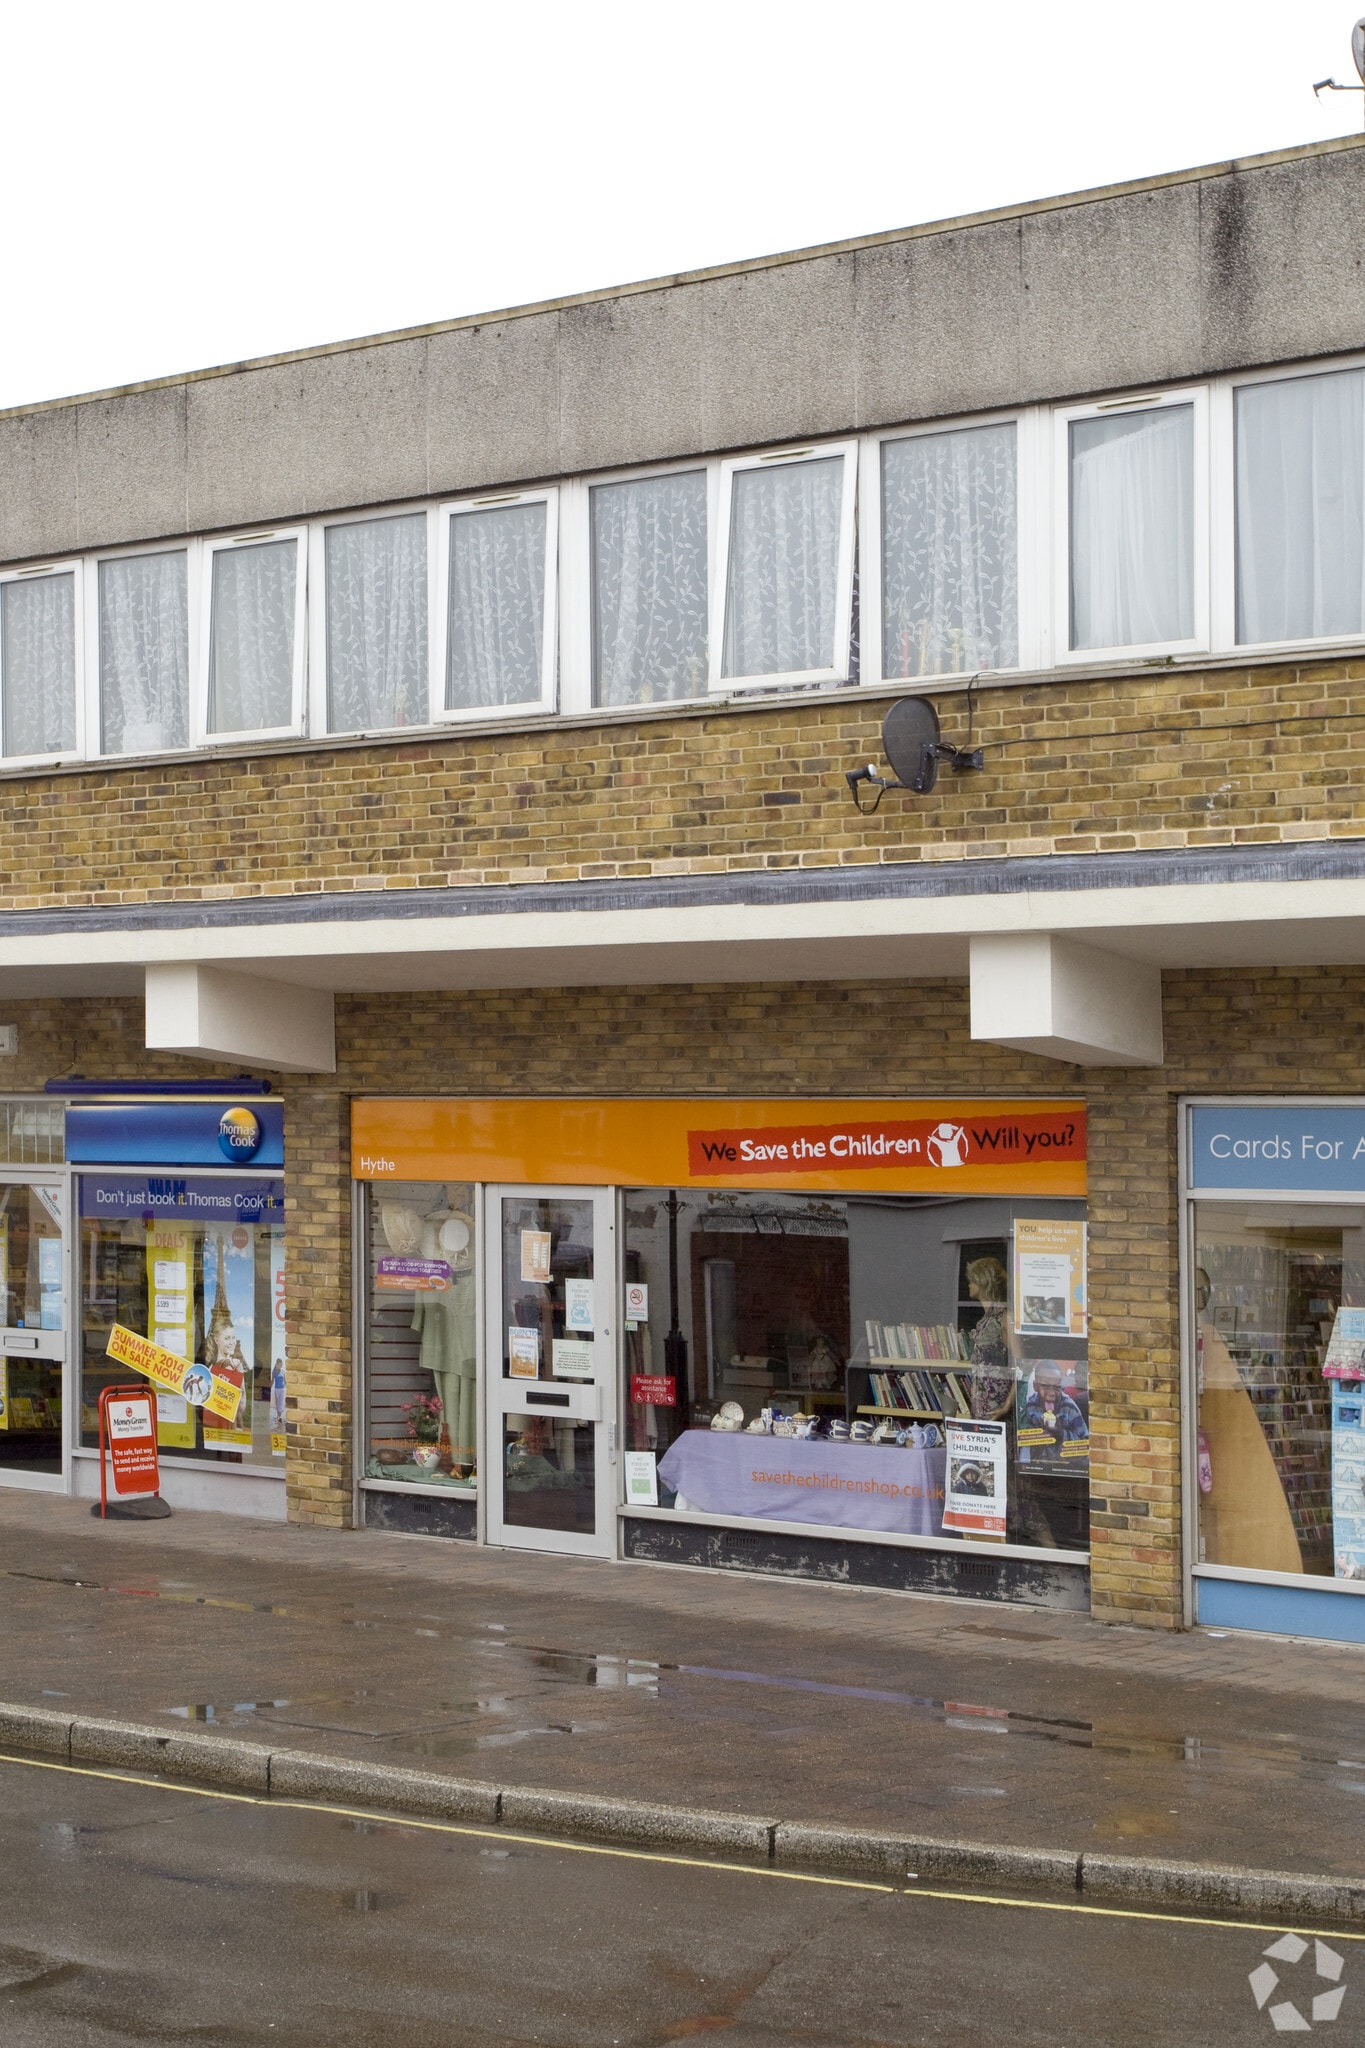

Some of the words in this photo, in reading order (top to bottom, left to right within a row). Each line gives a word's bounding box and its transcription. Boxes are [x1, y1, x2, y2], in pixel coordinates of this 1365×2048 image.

[219, 1122, 256, 1136] Thomas
[229, 1135, 256, 1147] Cook
[701, 1142, 737, 1163] We
[740, 1139, 788, 1162] Save
[791, 1137, 826, 1158] the
[829, 1134, 921, 1157] Children
[971, 1126, 1019, 1151] Will
[1023, 1124, 1075, 1155] you?
[1210, 1134, 1291, 1159] Cards
[1302, 1135, 1344, 1160] For
[361, 1157, 396, 1174] Hythe
[96, 1189, 125, 1204] Don't
[126, 1190, 146, 1206] just
[148, 1192, 176, 1206] book
[188, 1194, 232, 1208] Thomas
[234, 1193, 264, 1208] Cook
[266, 1195, 277, 1209] it.
[1019, 1225, 1037, 1233] YOU
[1038, 1226, 1053, 1235] help
[154, 1233, 185, 1249] DEALS
[114, 1329, 157, 1360] SUMMER
[160, 1353, 185, 1374] 2014
[111, 1342, 127, 1357] ON
[128, 1351, 152, 1370] SALE
[152, 1364, 182, 1384] NOW
[636, 1377, 652, 1385] Please
[662, 1378, 672, 1386] for
[641, 1385, 667, 1393] assistance
[113, 1417, 148, 1427] MoneyGram
[206, 1430, 211, 1439] 3
[966, 1434, 996, 1444] SYRIA'S
[273, 1437, 279, 1448] 3
[123, 1448, 134, 1456] safe,
[134, 1447, 143, 1455] fast
[134, 1463, 157, 1471] worldwide
[751, 1470, 945, 1499] savethechildrenshop.co.uk
